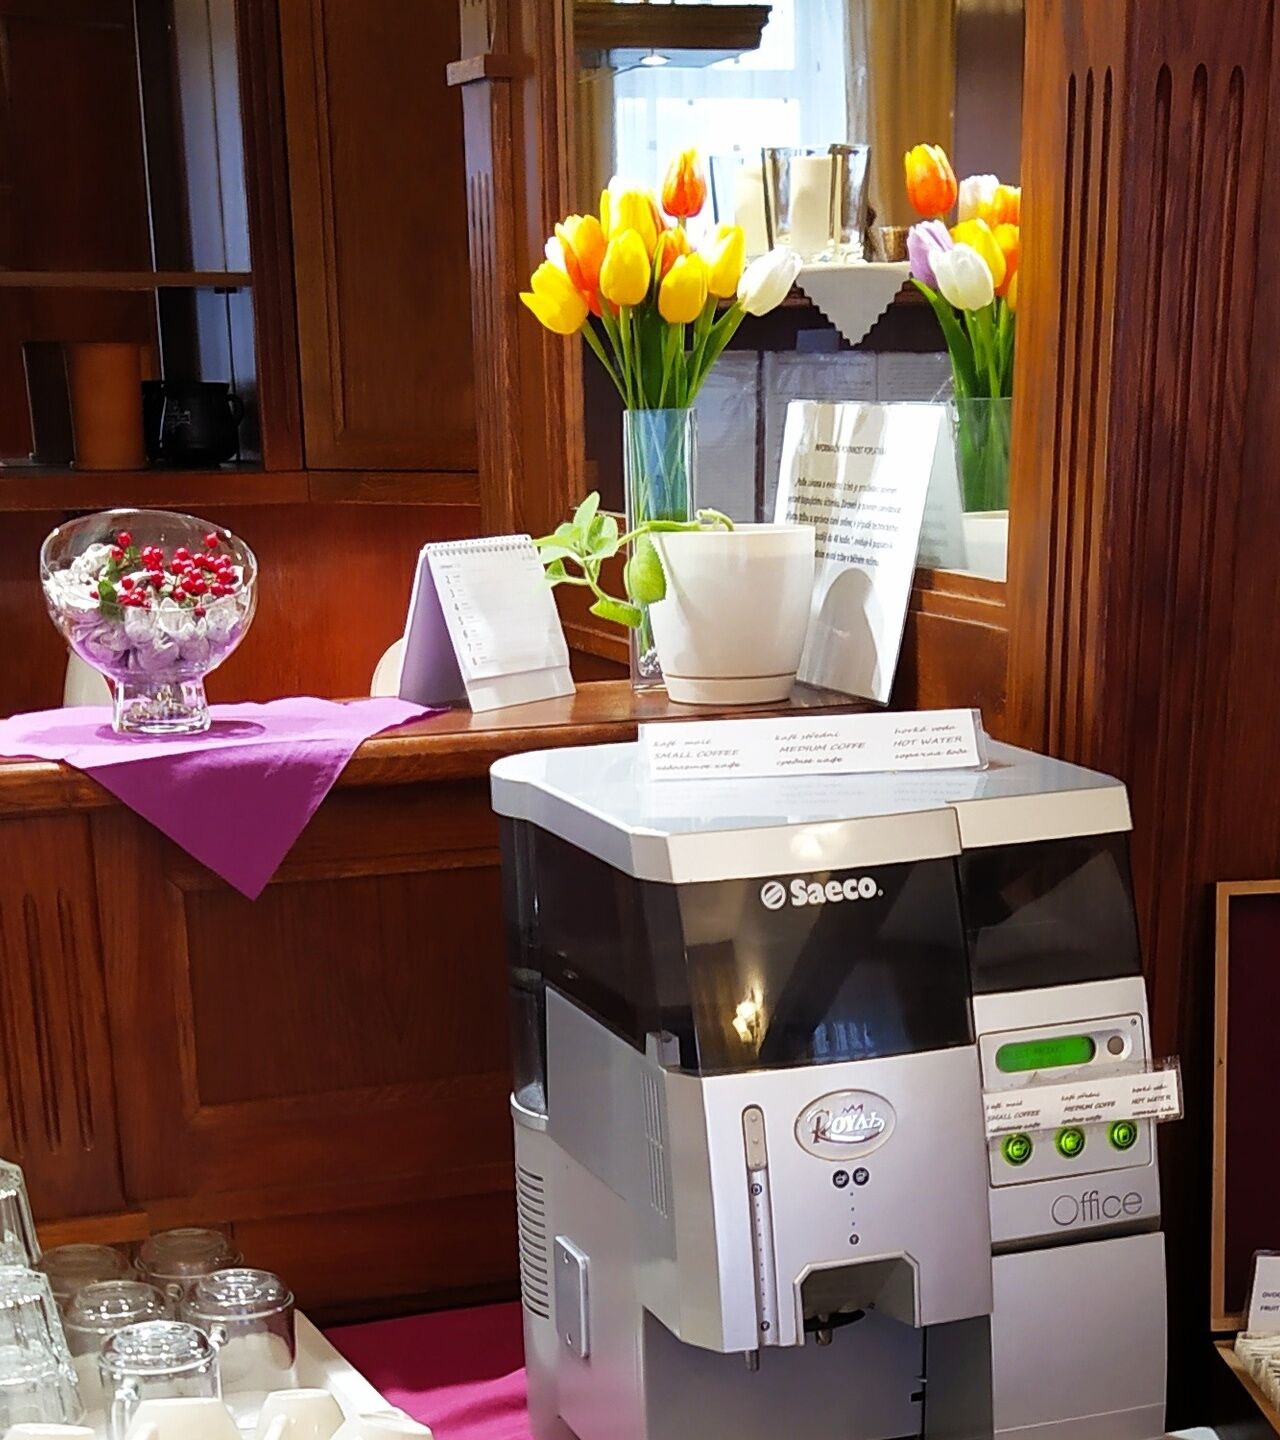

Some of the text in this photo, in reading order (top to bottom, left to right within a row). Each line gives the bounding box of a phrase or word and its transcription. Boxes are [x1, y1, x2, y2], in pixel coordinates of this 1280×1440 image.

[779, 741, 866, 753] MEDIUM COFFE
[893, 736, 963, 747] HOT WATER
[654, 749, 740, 760] SMALL COFFEE
[790, 877, 877, 906] Saeco
[1051, 1190, 1143, 1226] Office
